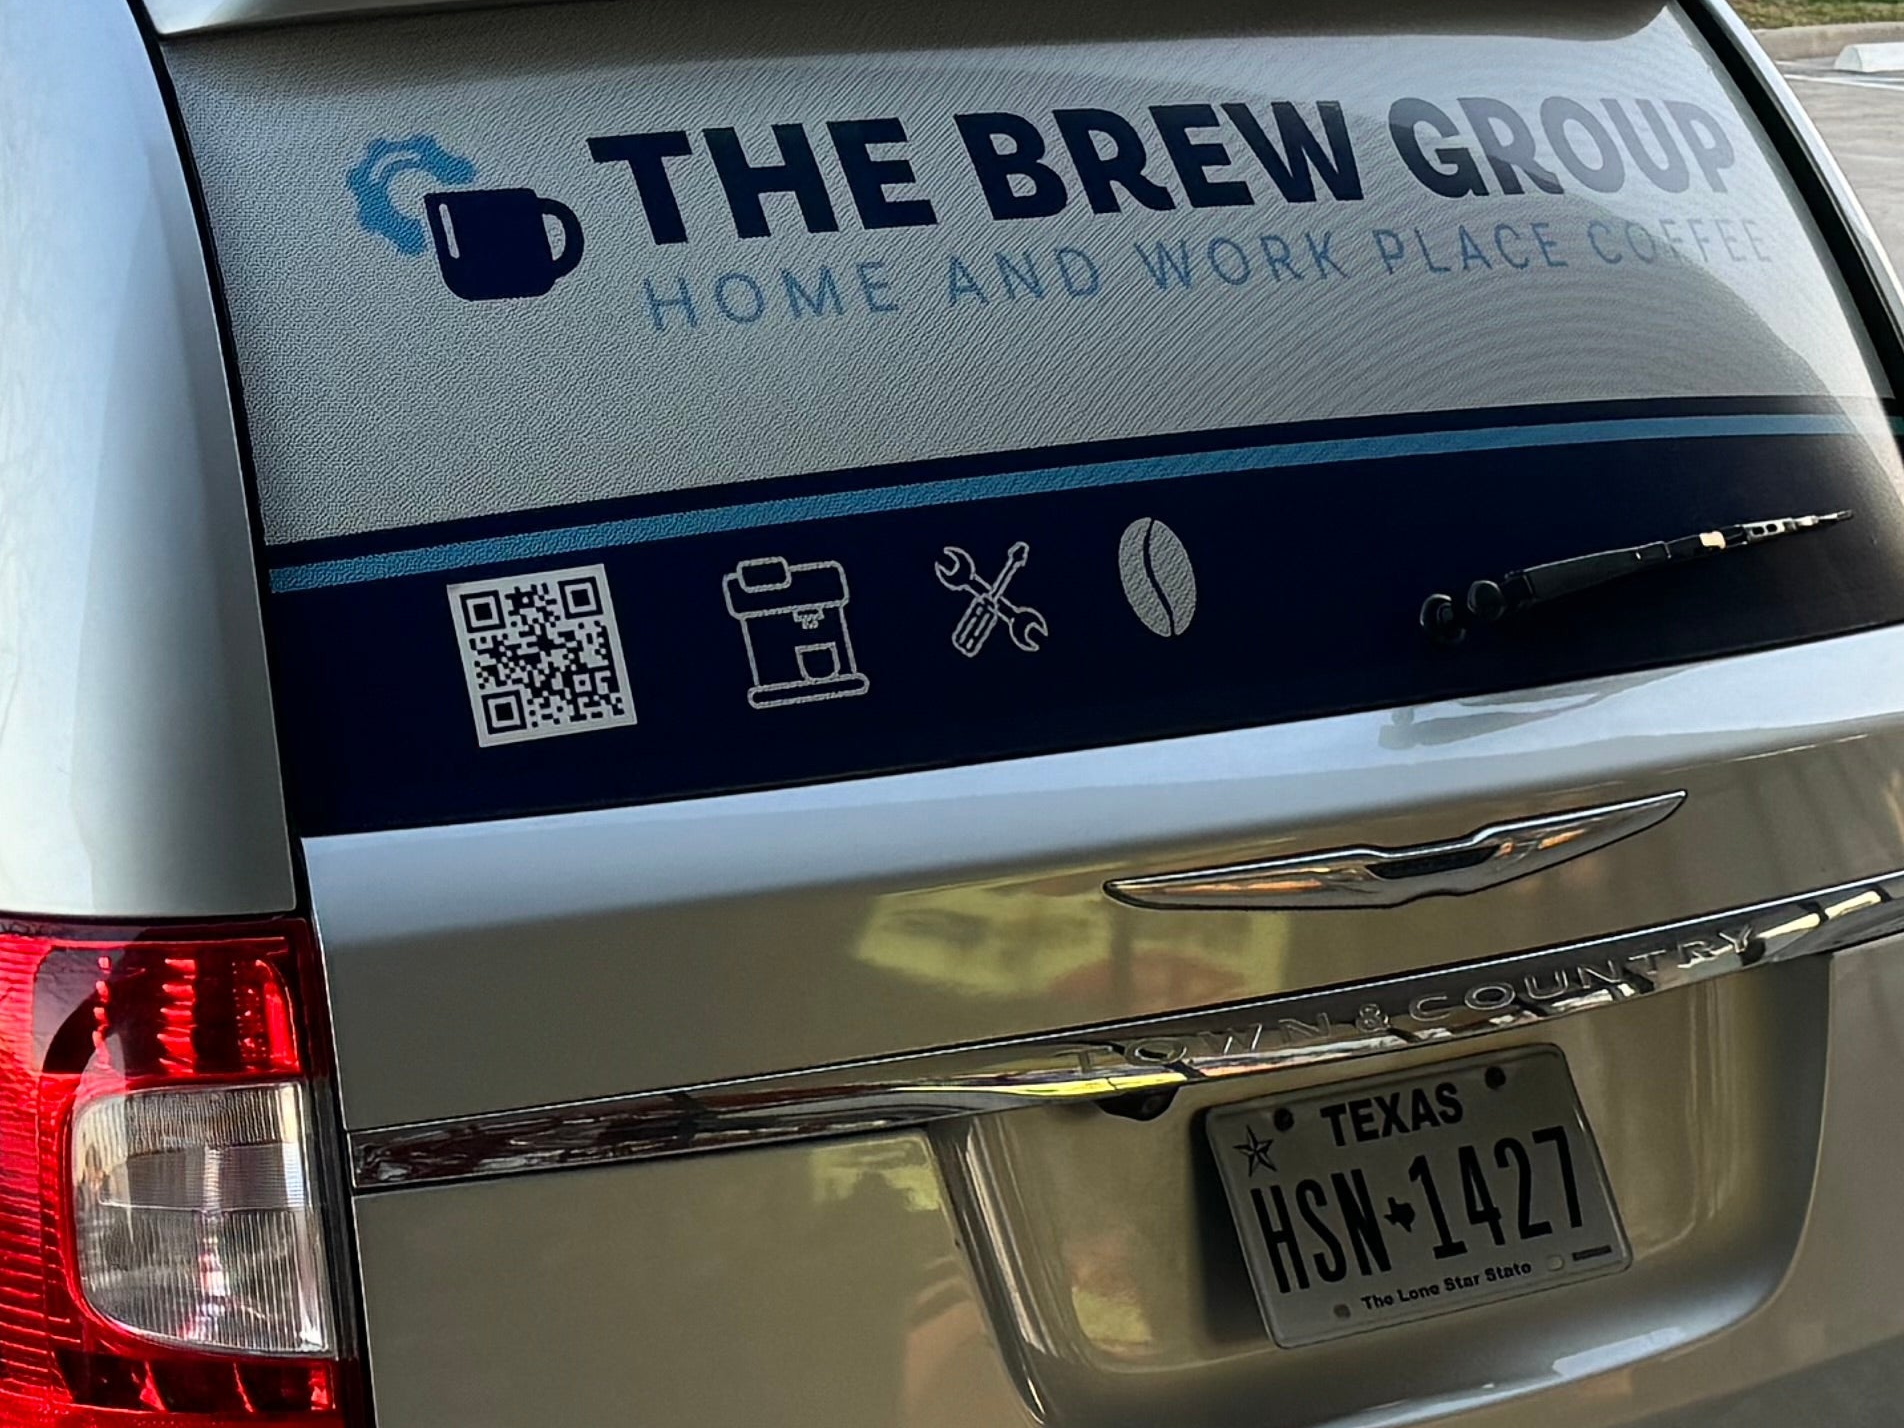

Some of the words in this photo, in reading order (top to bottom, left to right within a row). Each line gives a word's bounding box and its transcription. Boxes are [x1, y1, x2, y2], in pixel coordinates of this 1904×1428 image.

[586, 117, 938, 246] THE
[953, 101, 1364, 221] BREW
[1388, 96, 1735, 199] GROUP
[643, 260, 899, 332] HOME
[948, 246, 1100, 307] AND
[1134, 231, 1348, 291] WORK
[1372, 222, 1568, 274] PLACE
[1587, 218, 1773, 265] COFFEE
[1320, 1081, 1464, 1146] TEXAS
[1361, 1295, 1394, 1310] The
[1397, 1284, 1441, 1302] Lone
[1443, 1273, 1480, 1291] Star
[1484, 1262, 1532, 1282] State
